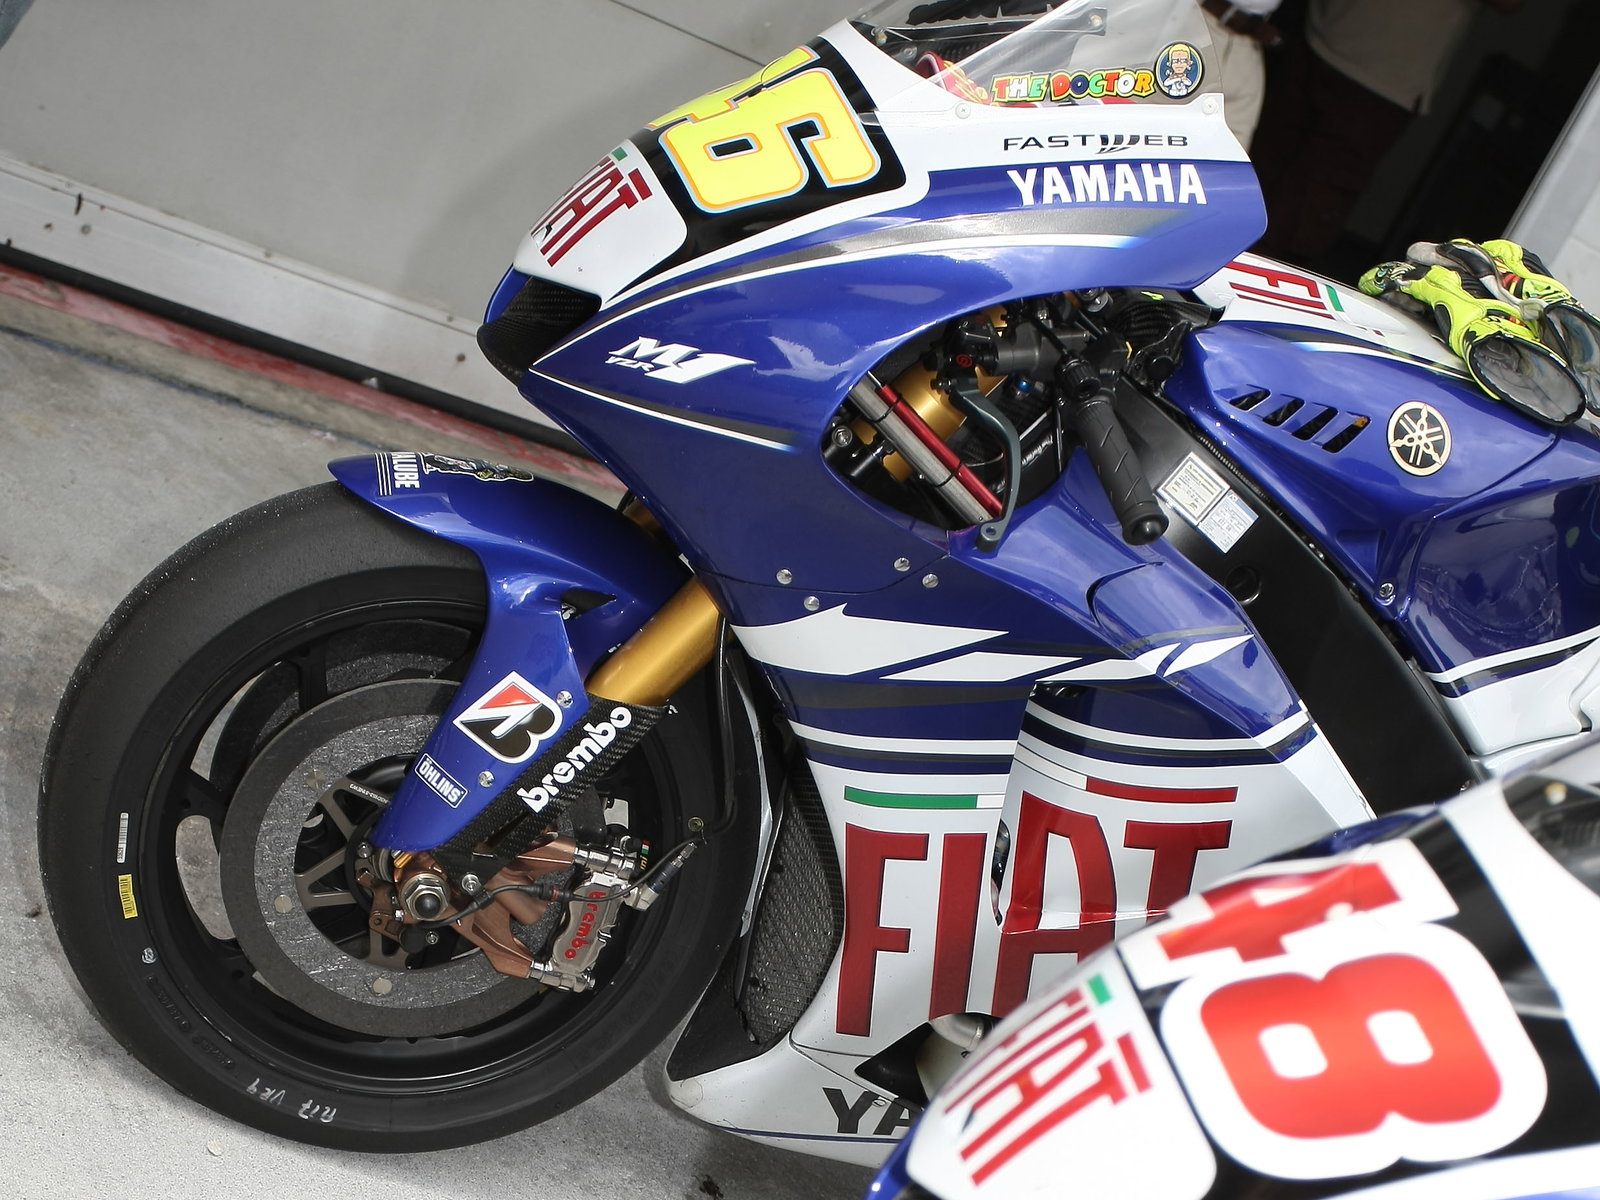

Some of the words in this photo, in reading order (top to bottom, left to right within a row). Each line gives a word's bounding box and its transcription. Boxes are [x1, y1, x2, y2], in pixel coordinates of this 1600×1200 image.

[992, 73, 1049, 101] THE
[1050, 68, 1155, 99] DOCTOR
[1003, 134, 1189, 155] FASTWEB
[531, 156, 639, 268] IAT
[1006, 163, 1208, 206] YAMAHA
[1223, 260, 1337, 321] FI
[391, 451, 421, 489] ALUBE
[418, 757, 465, 804] ÖHLINS
[517, 706, 632, 813] brembo
[836, 791, 1233, 1037] FIAT
[1140, 850, 1524, 1160] 48
[942, 986, 1129, 1187] FIAT
